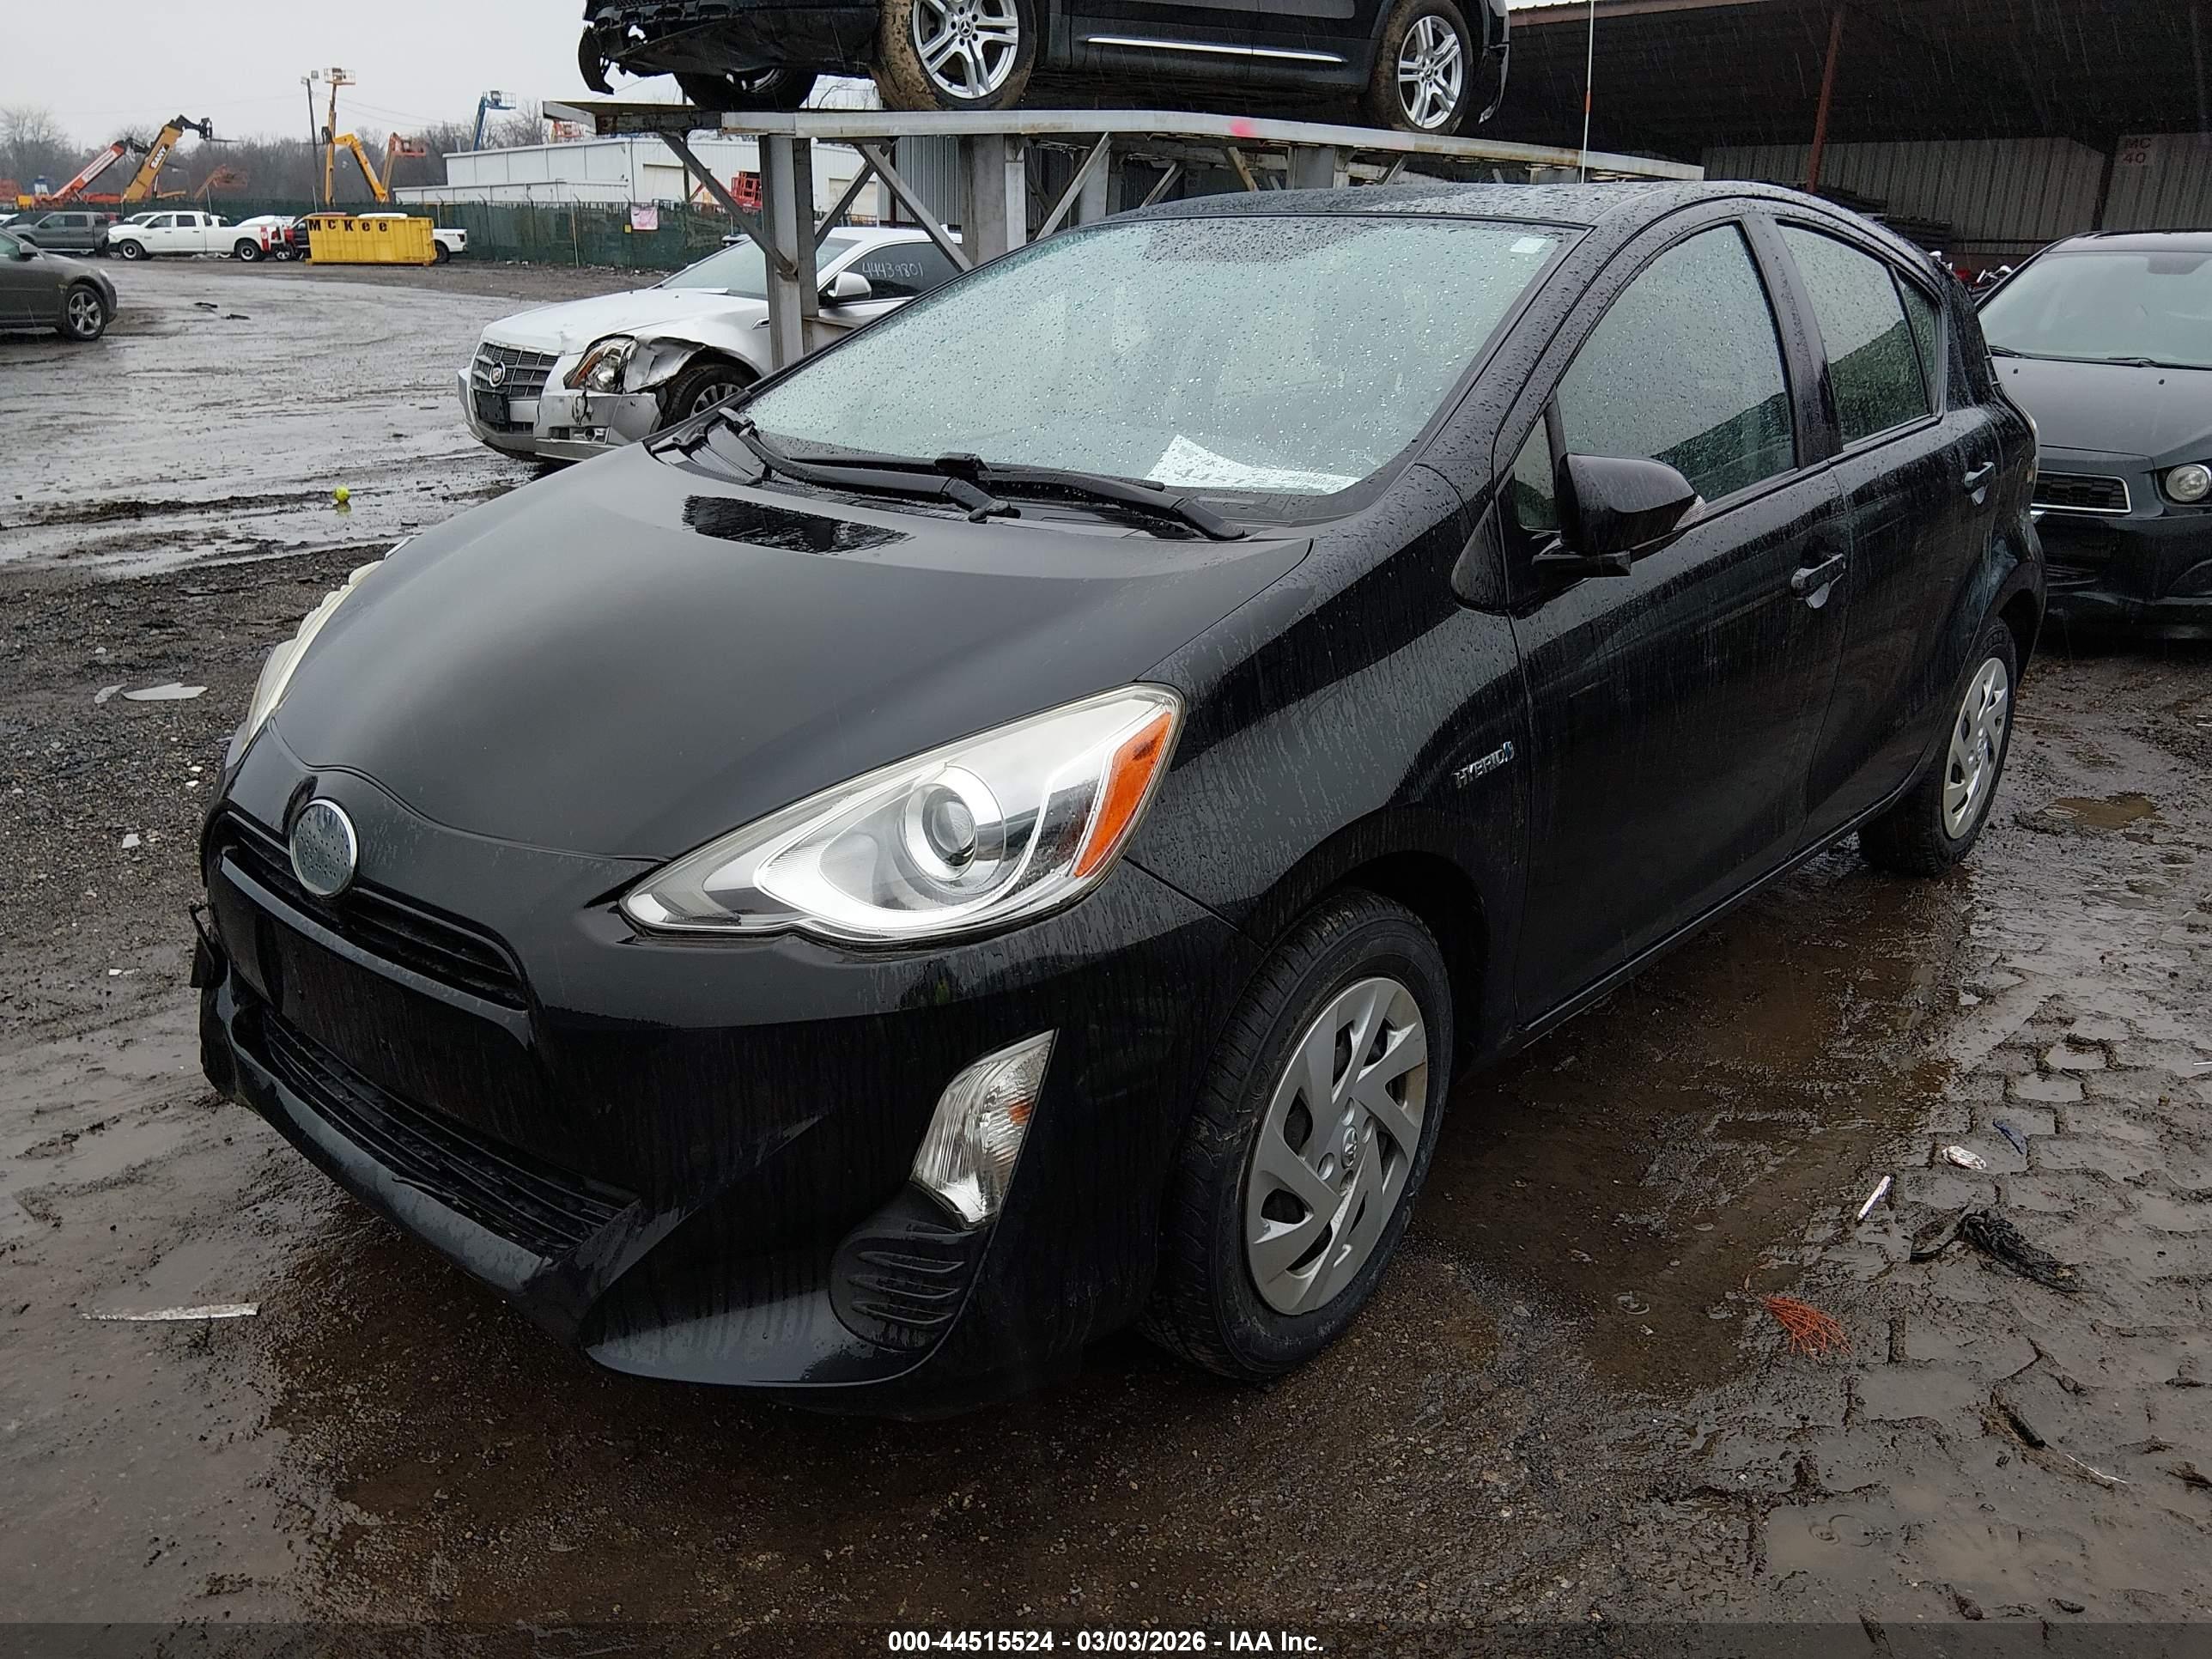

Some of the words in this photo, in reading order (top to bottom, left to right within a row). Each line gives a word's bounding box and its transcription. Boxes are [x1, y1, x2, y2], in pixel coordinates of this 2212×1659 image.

[2122, 152, 2146, 163] 40
[862, 262, 924, 278] 44439801
[1451, 749, 1505, 788] HYBRID
